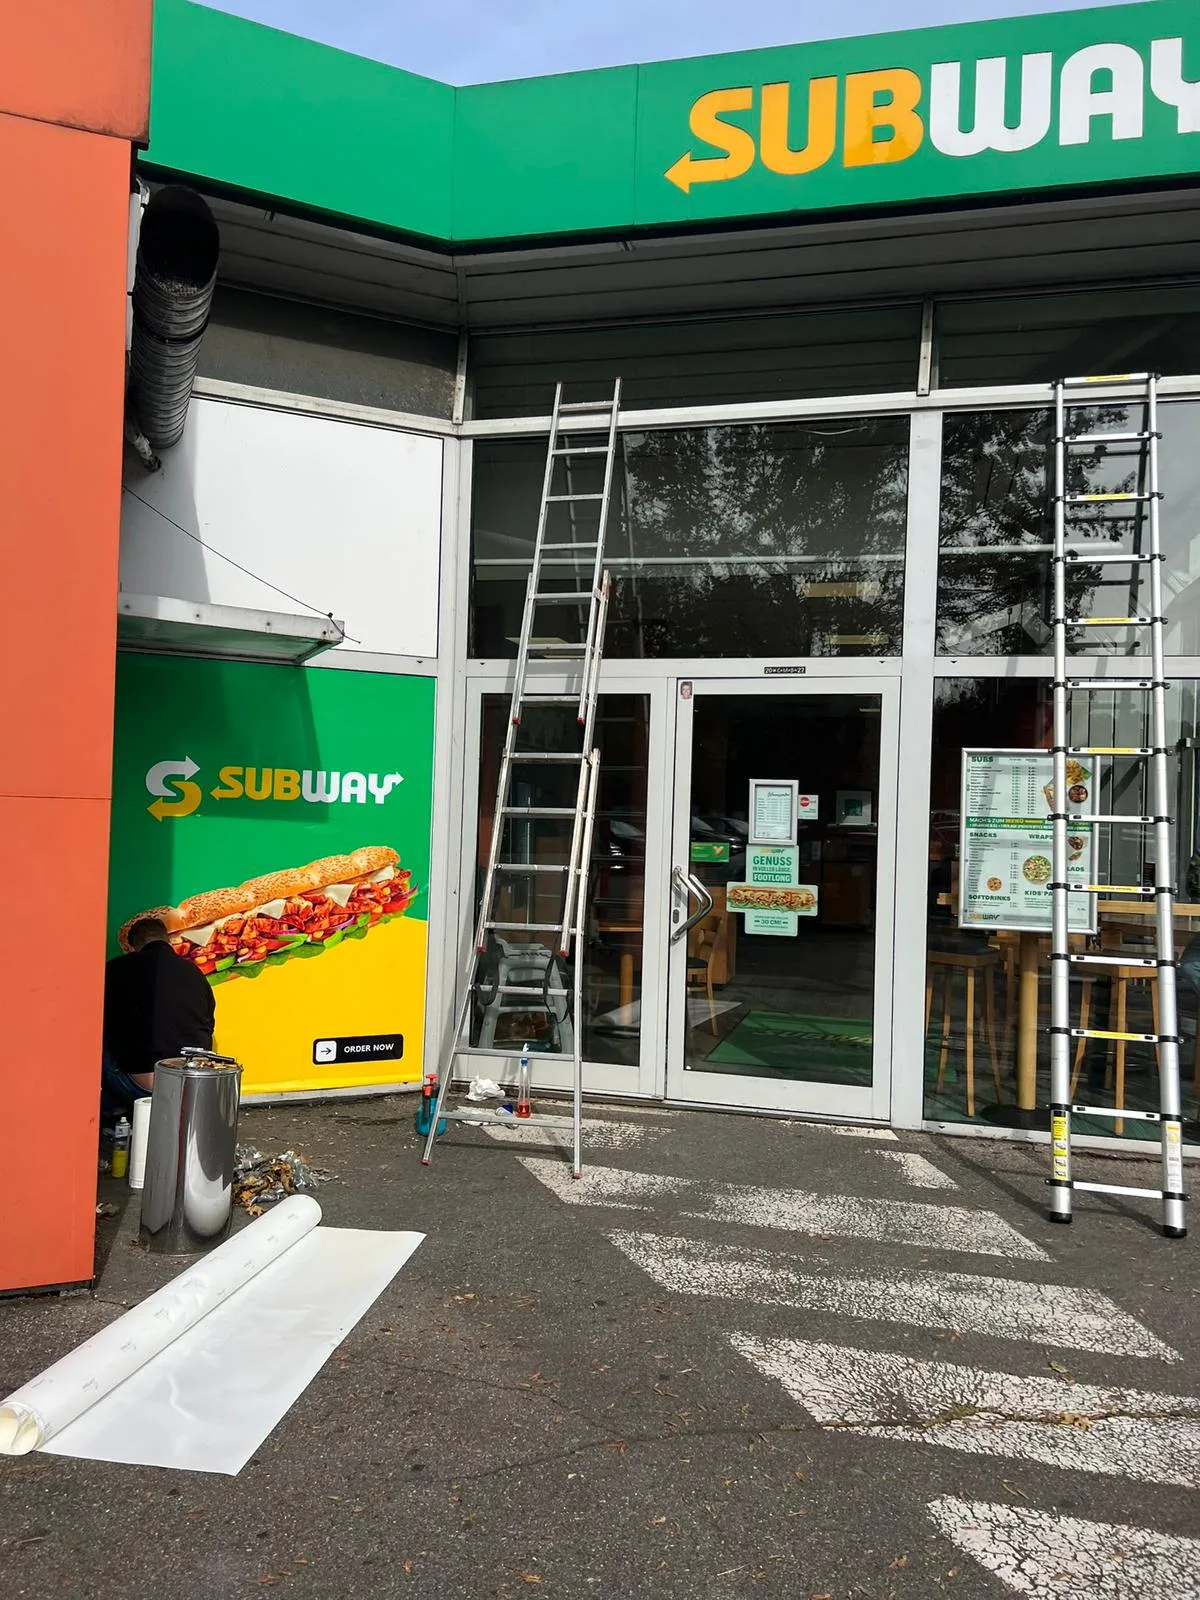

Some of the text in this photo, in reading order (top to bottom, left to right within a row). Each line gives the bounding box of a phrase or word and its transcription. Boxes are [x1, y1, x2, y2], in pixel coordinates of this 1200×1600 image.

[210, 766, 404, 804] SUBWAY
[752, 855, 792, 866] GENUSS
[753, 873, 791, 882] FOOTLONG
[343, 1043, 395, 1053] ORDER NOW
